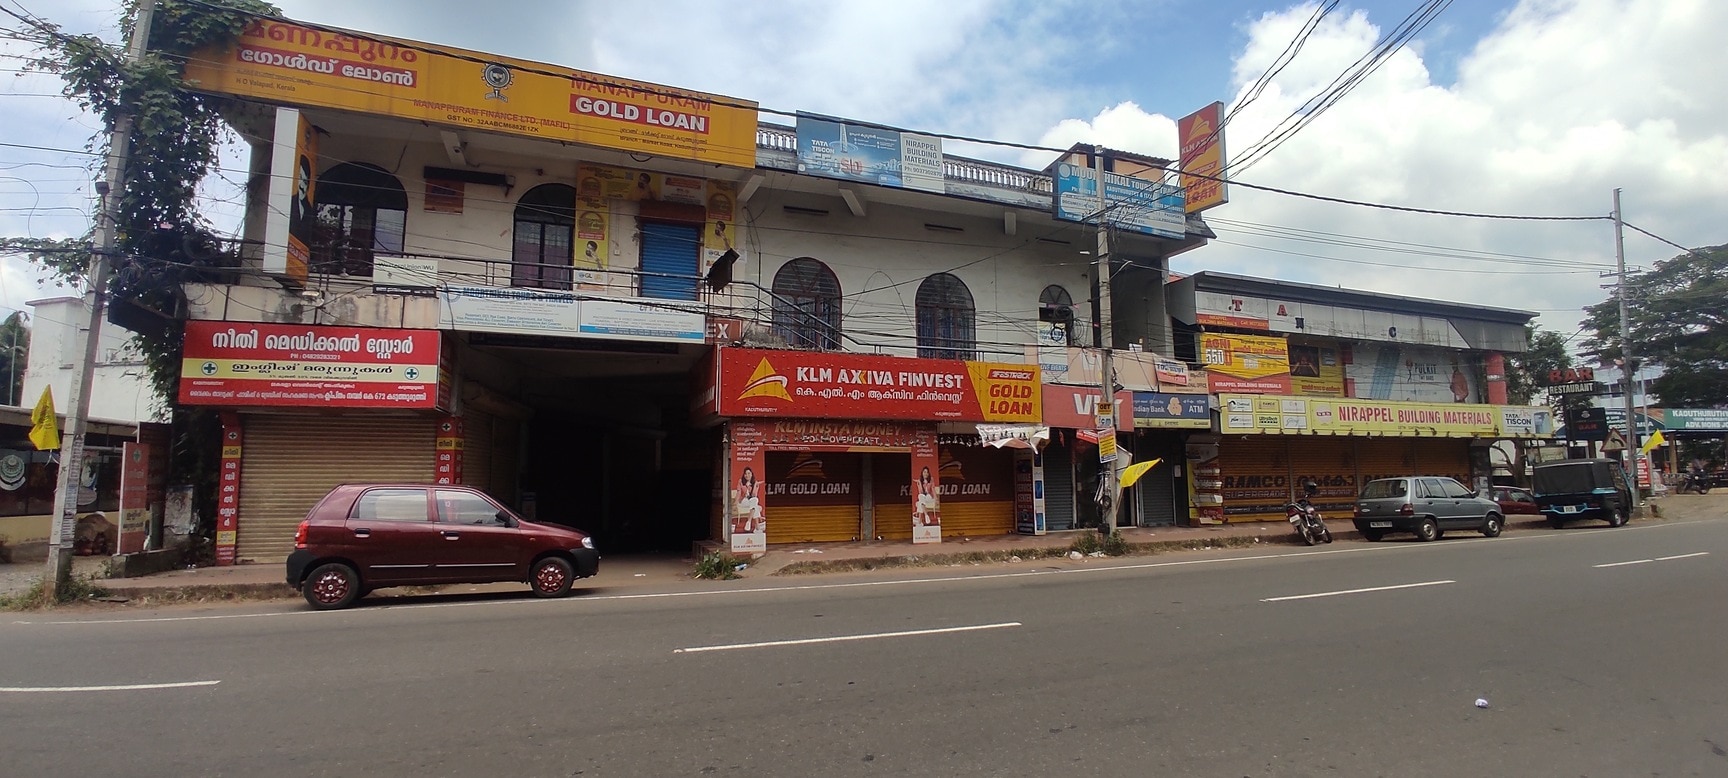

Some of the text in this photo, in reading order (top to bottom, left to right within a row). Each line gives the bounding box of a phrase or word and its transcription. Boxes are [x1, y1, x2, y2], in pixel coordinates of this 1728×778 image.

[241, 48, 339, 74] ഗോൾഡ്
[342, 64, 413, 87] ലോൺ
[571, 73, 711, 112] MANAPPURAM
[575, 96, 706, 132] GOLD LOAN
[811, 139, 829, 147] TATA
[905, 139, 938, 152] NIRAPPEL
[811, 146, 835, 154] TISCON
[906, 148, 938, 160] BUILDING
[904, 155, 941, 168] MATERIALS
[212, 328, 414, 359] നീതി മെഡിക്കൽ സ്റ്റോർ
[232, 362, 392, 376] ഇംഗ്ലീഷ് മരുന്നുകൾ
[1549, 366, 1594, 383] BAR
[796, 366, 832, 383] KLM
[898, 371, 964, 389] FINVEST
[990, 383, 1033, 398] GOLD
[1549, 382, 1594, 395] RESTAURANT
[374, 392, 386, 400] 672
[990, 400, 1033, 415] LOAN
[1134, 404, 1166, 413] ndian Bank
[1188, 405, 1204, 414] ATM
[1338, 406, 1492, 426] NIRAPPEL BUILDING MATERIALS
[775, 421, 901, 436] KLM INSTA MONEY
[1225, 475, 1285, 488] RAMCO
[790, 483, 818, 495] GOLD
[821, 482, 850, 494] LOAN
[962, 483, 990, 495] LOAN
[1225, 490, 1286, 499] SUPERGRADE
